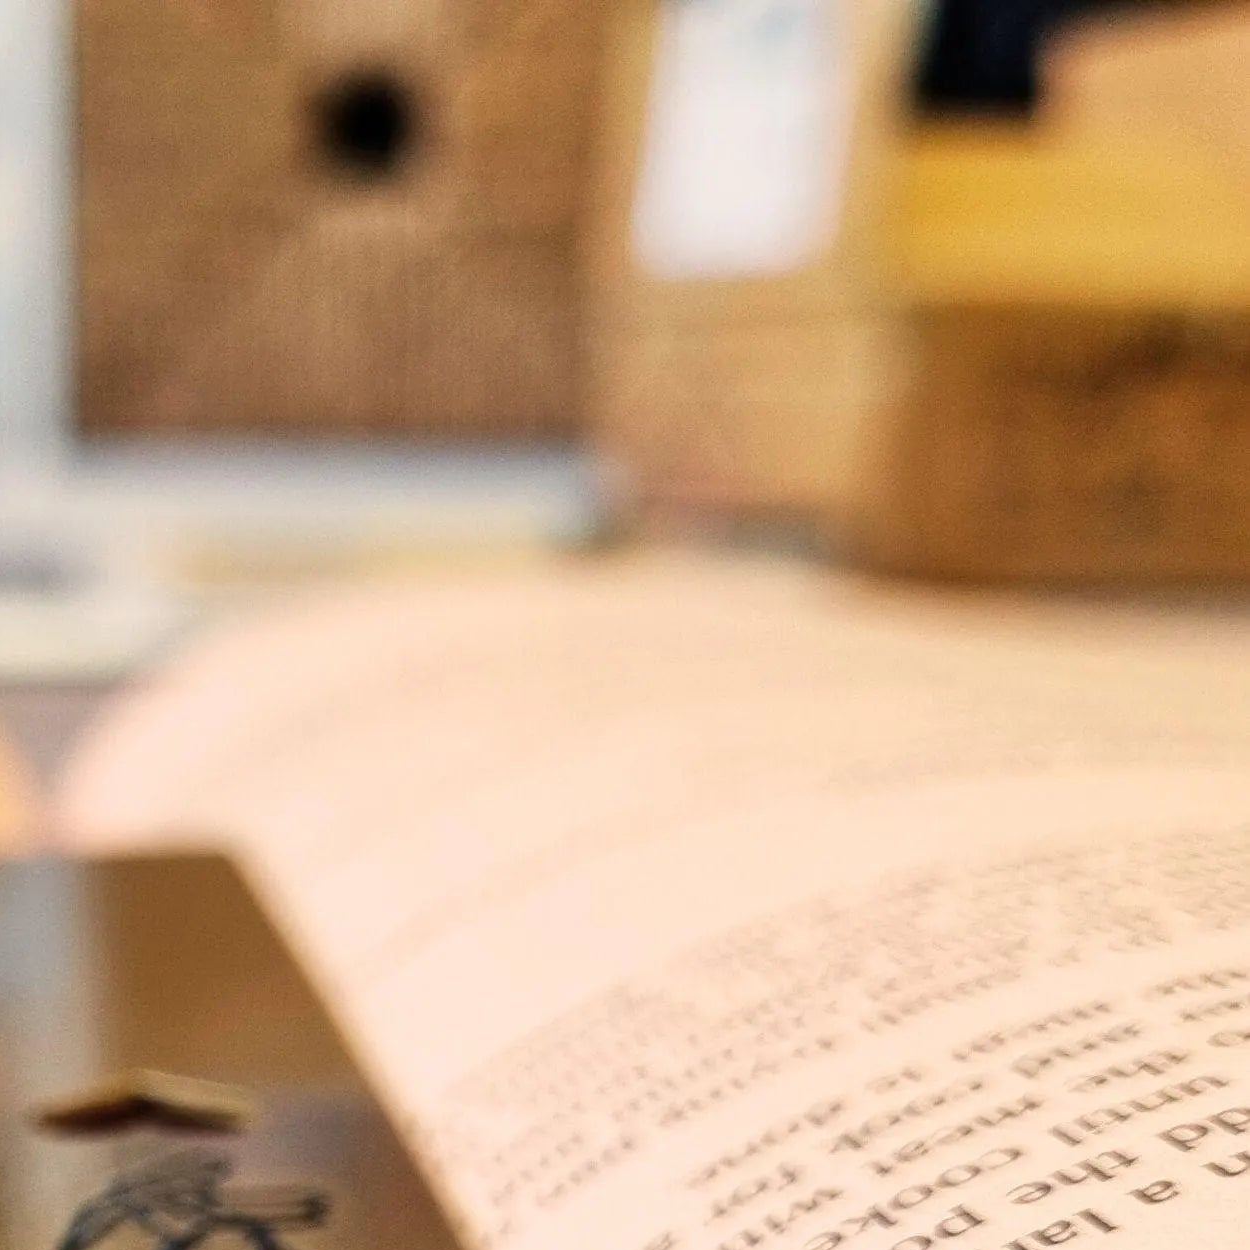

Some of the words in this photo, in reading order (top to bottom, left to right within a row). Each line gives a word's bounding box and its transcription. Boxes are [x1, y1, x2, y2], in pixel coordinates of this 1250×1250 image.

[1063, 1051, 1190, 1094] the
[1048, 1075, 1230, 1148] until
[1155, 1108, 1250, 1152] dd
[866, 1094, 1044, 1179] meat
[1005, 1150, 1140, 1205] the
[1127, 1179, 1180, 1205] a
